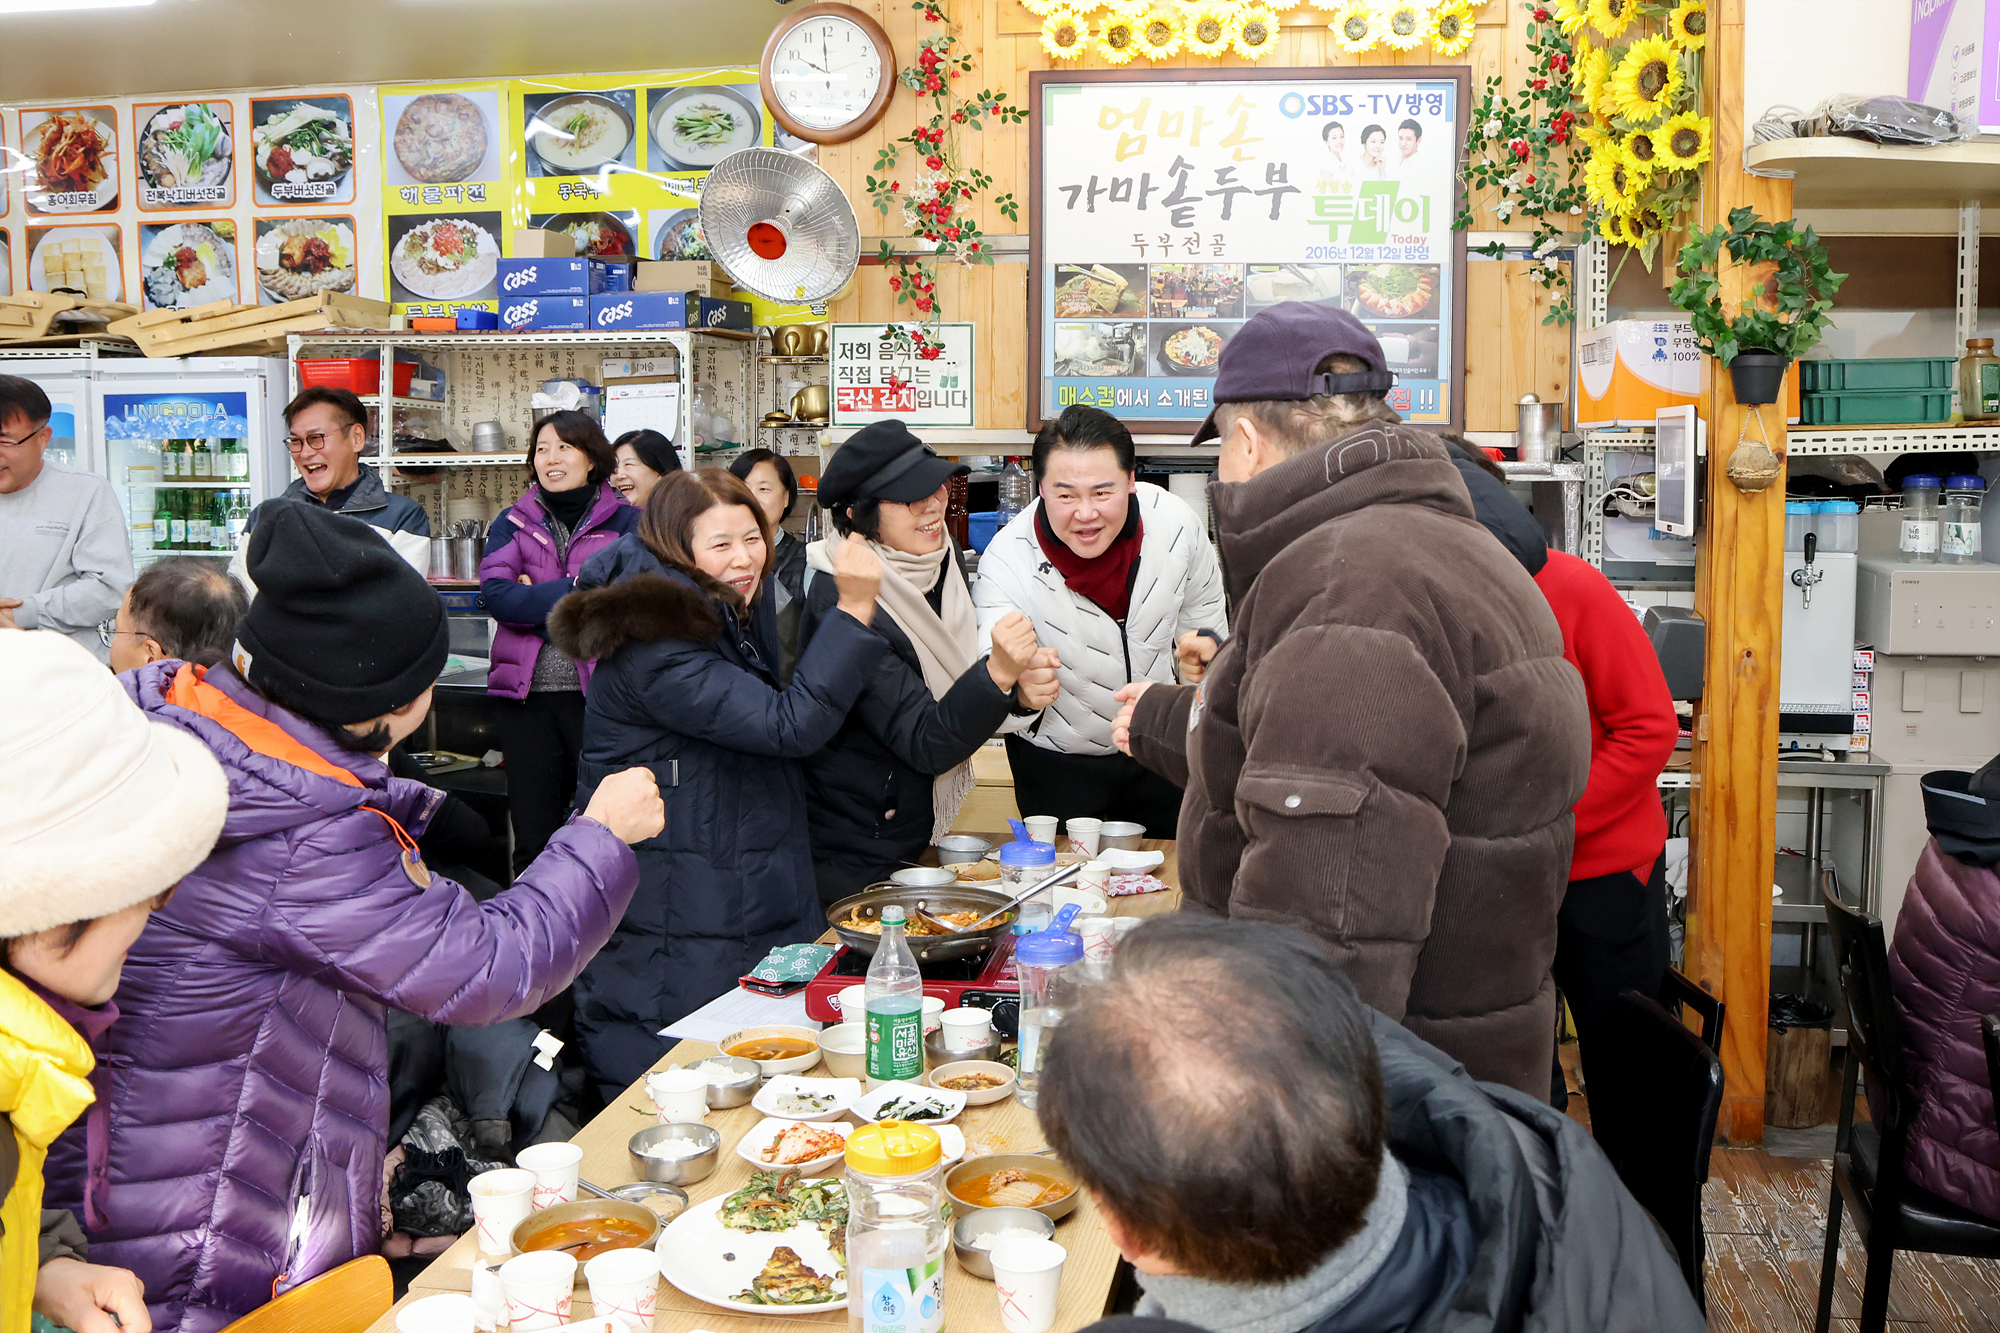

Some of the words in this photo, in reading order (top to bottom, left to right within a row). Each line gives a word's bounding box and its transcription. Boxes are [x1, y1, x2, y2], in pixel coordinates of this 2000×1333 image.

[804, 32, 813, 43] 11
[789, 49, 800, 61] 10
[860, 46, 868, 57] 2
[866, 67, 874, 79] 3
[1307, 94, 1354, 116] SBS
[1097, 93, 1265, 163] 엄마손
[271, 183, 336, 198] 두부버섯전골
[400, 183, 486, 205] 해물파전
[1058, 154, 1303, 229] 가마솥두부
[1315, 180, 1353, 194] 생방송
[47, 191, 97, 207] 홍어회무침
[146, 187, 226, 202] 전복낙지버섯전골
[1306, 192, 1431, 243] 투데이
[1130, 231, 1227, 258] 두부전골
[1391, 234, 1427, 245] Today
[1305, 246, 1347, 260] 2016년
[1350, 246, 1374, 260] 12월
[1377, 246, 1401, 260] 12일
[1404, 245, 1430, 260] 방영
[511, 317, 533, 330] FRESH
[1673, 323, 1696, 334] 부드
[838, 342, 871, 361] 저희
[1673, 351, 1701, 361] 100%
[838, 366, 871, 384] 직접
[879, 366, 931, 384] 담그는
[838, 389, 874, 410] 국산
[879, 389, 967, 410] 김치입니다
[1058, 385, 1150, 408] 매스컴에서
[1156, 388, 1208, 408] 소개된
[1385, 388, 1411, 411] 집
[1419, 388, 1434, 411] !!
[896, 1026, 916, 1038] 서울
[896, 1036, 916, 1048] 미래
[896, 1045, 916, 1058] 유산
[881, 1294, 892, 1306] 참
[883, 1304, 896, 1316] 이슬
